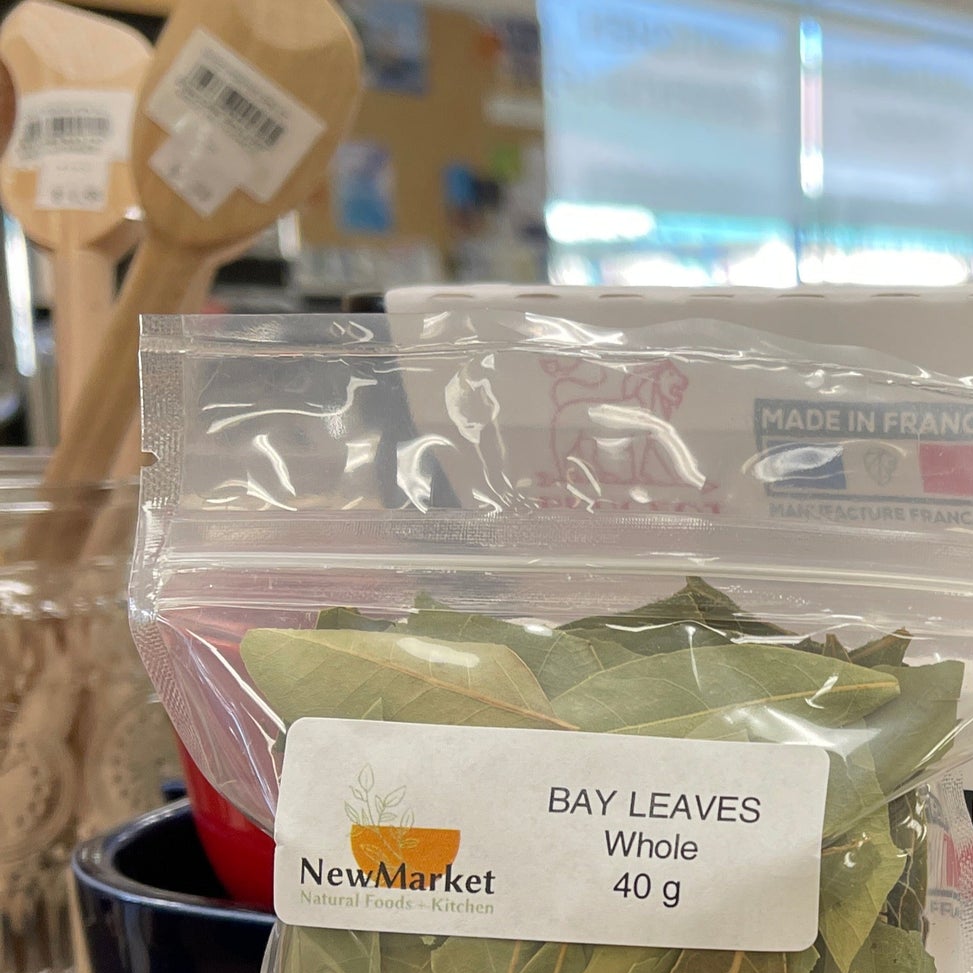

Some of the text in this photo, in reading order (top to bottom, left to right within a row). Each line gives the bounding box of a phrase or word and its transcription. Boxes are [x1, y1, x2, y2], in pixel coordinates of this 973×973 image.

[761, 407, 841, 431] MADE
[848, 410, 876, 433] IN
[548, 786, 762, 824] BAY LEAVES
[604, 829, 699, 861] Whole
[300, 857, 496, 894] NewMarket
[613, 872, 681, 908] 40 g
[300, 889, 360, 908] Natural
[365, 893, 413, 911] Foods
[431, 896, 495, 915] Kitchen
